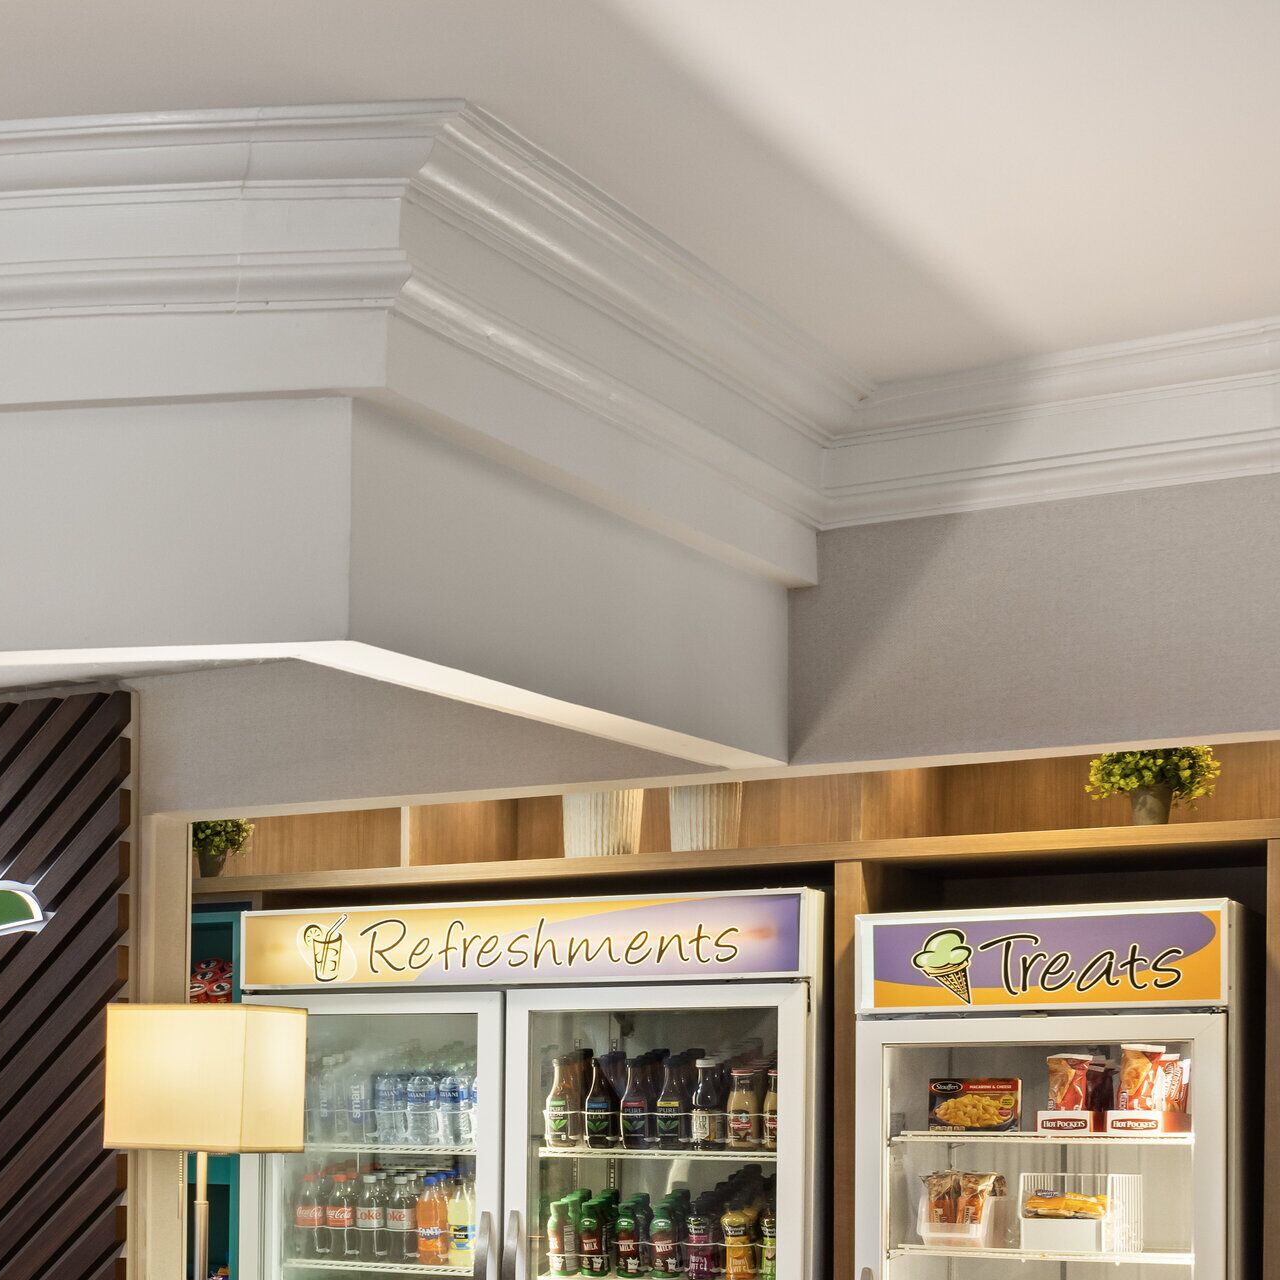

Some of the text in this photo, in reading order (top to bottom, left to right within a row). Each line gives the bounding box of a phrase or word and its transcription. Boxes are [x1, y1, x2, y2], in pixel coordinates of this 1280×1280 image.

[358, 917, 742, 975] Refreshments
[979, 933, 1185, 997] Treats
[350, 1084, 361, 1119] smart
[1043, 1120, 1086, 1128] HOT POCKETS
[1113, 1120, 1157, 1129] HOT POCKETS
[356, 1210, 381, 1221] oke
[387, 1212, 405, 1222] oke
[583, 1243, 599, 1251] MILK
[618, 1244, 635, 1252] MILK
[654, 1244, 673, 1253] MILK
